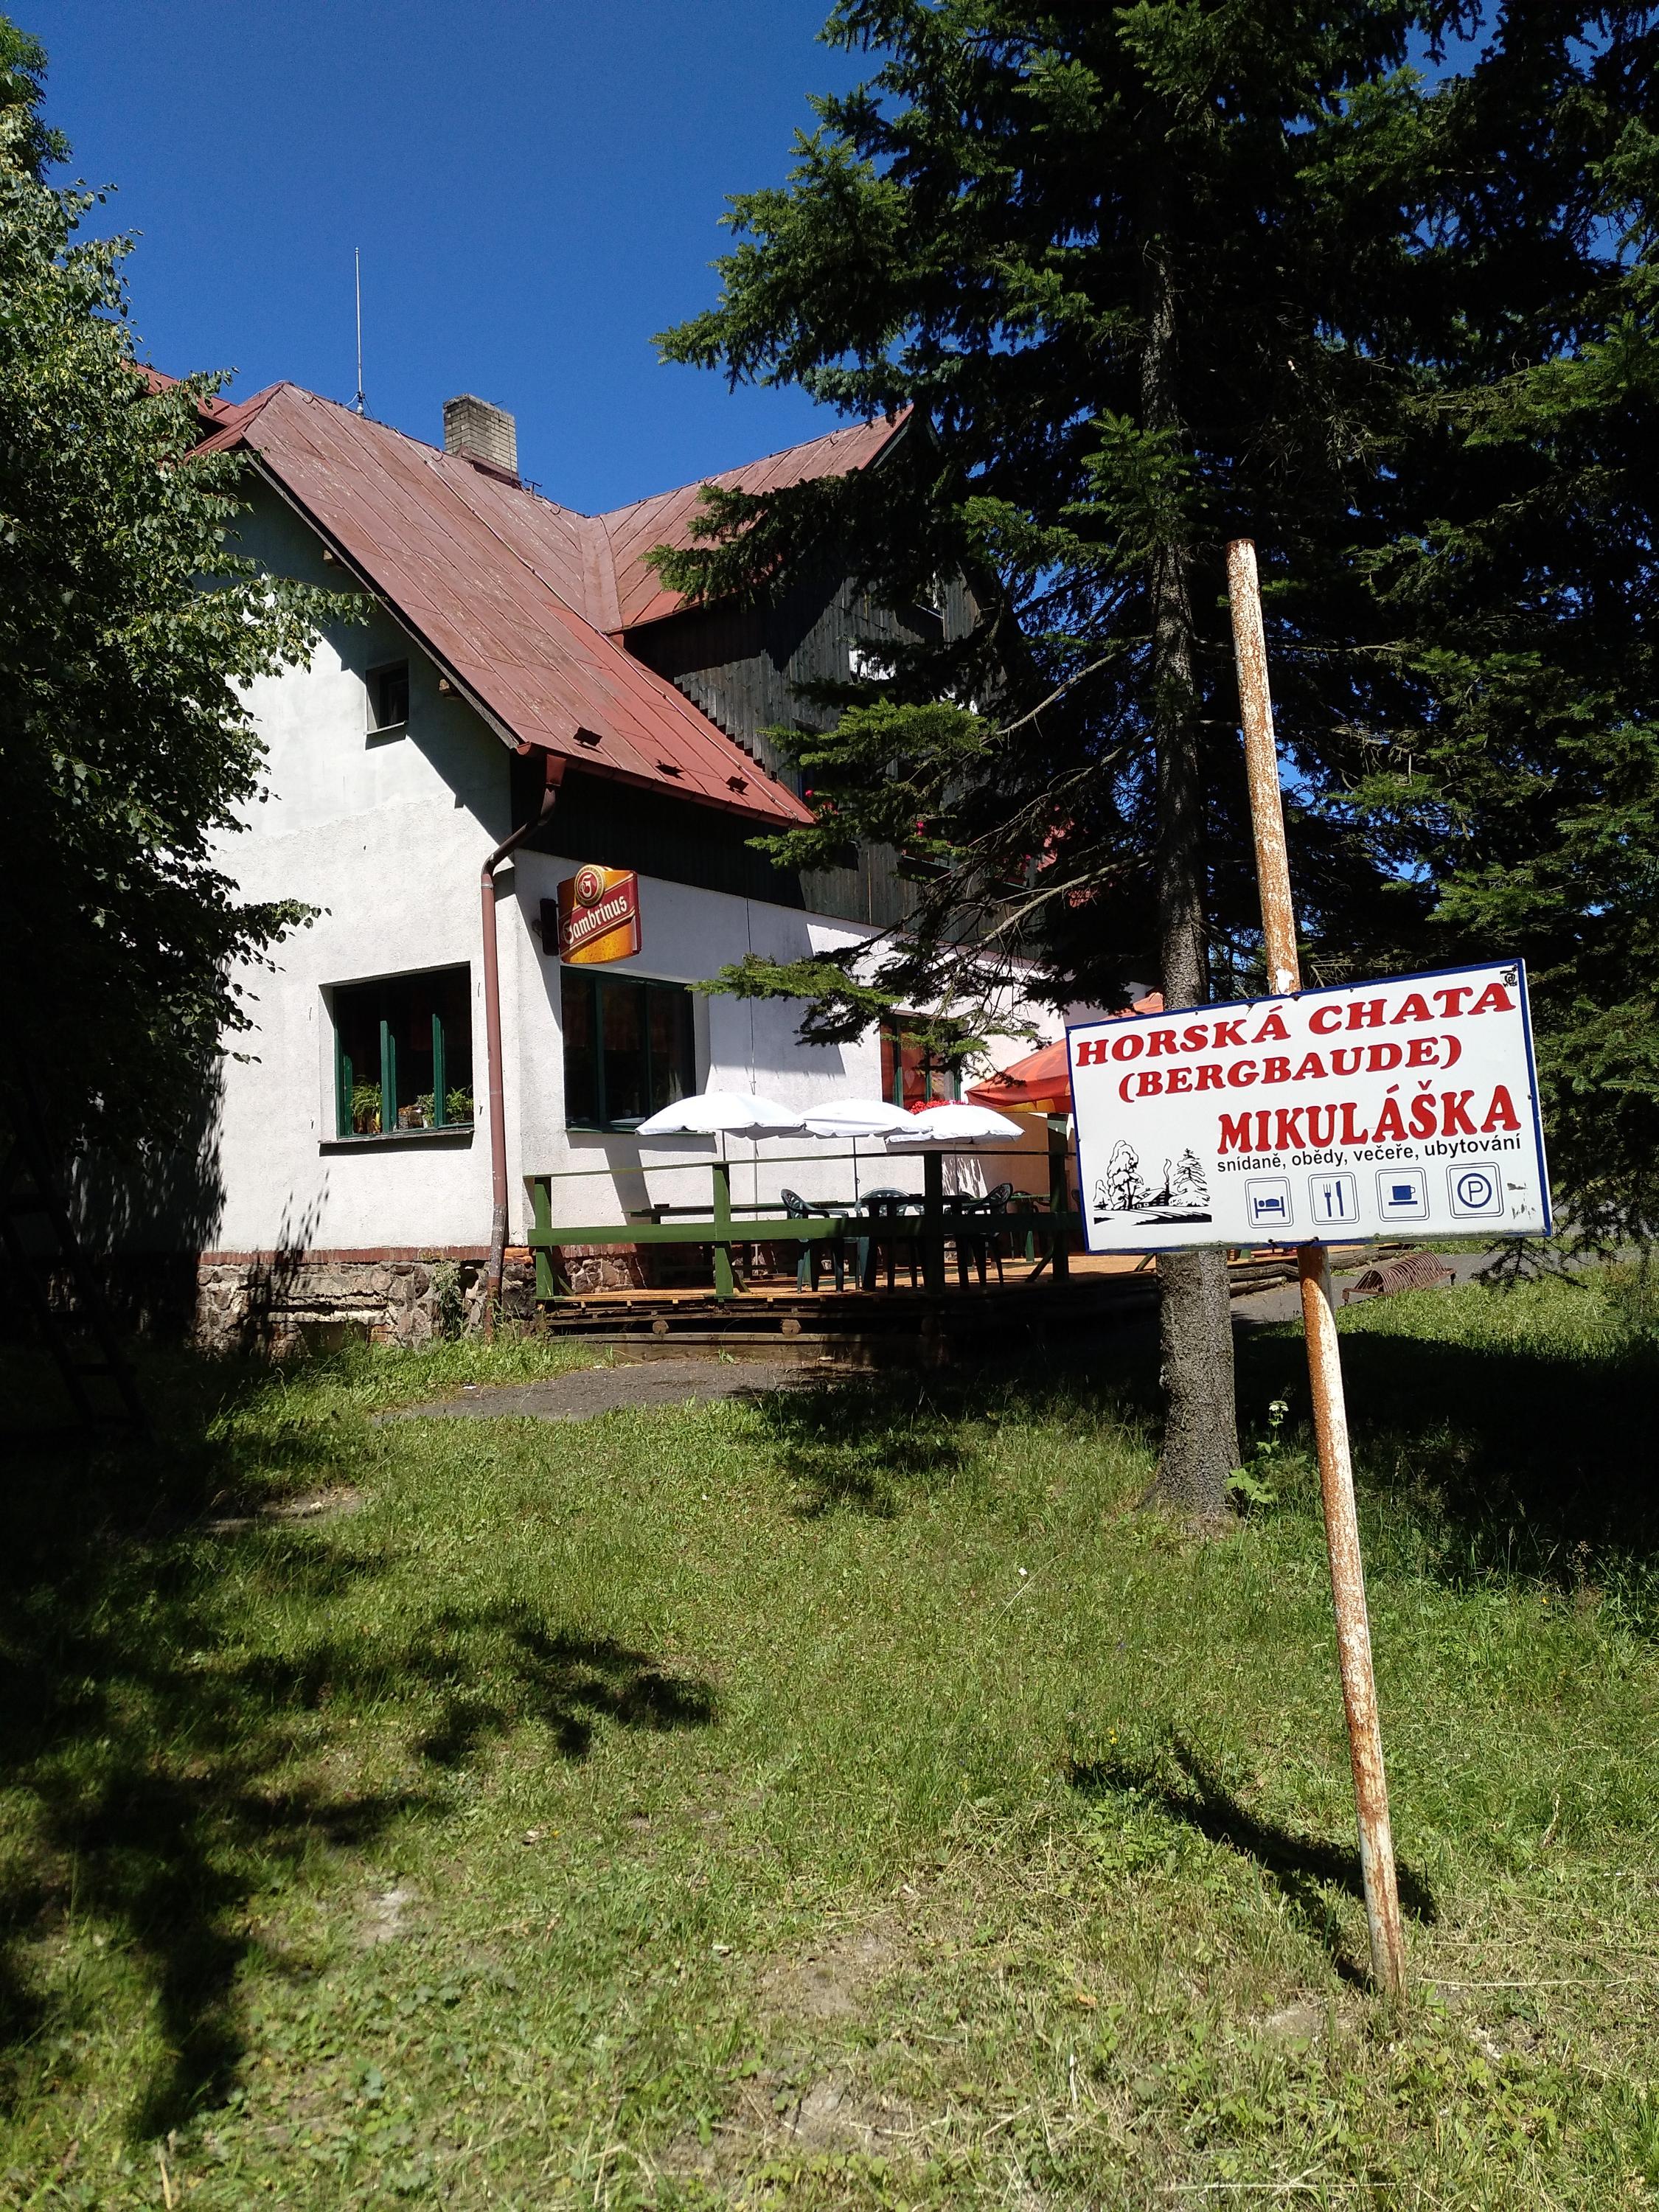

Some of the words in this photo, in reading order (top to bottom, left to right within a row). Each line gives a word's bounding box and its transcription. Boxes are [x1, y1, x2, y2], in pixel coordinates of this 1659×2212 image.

[563, 895, 627, 945] Gambrinus
[1076, 1006, 1290, 1067] HORSKÁ
[1309, 983, 1515, 1035] CHATA
[1118, 1034, 1462, 1103] (BERGBAUDE)
[1217, 1079, 1521, 1155] MIKULÁŠKA
[1217, 1152, 1286, 1172] snídaně,
[1292, 1147, 1348, 1167] obědy,
[1353, 1143, 1419, 1163] večeře,
[1425, 1133, 1520, 1159] ubytování
